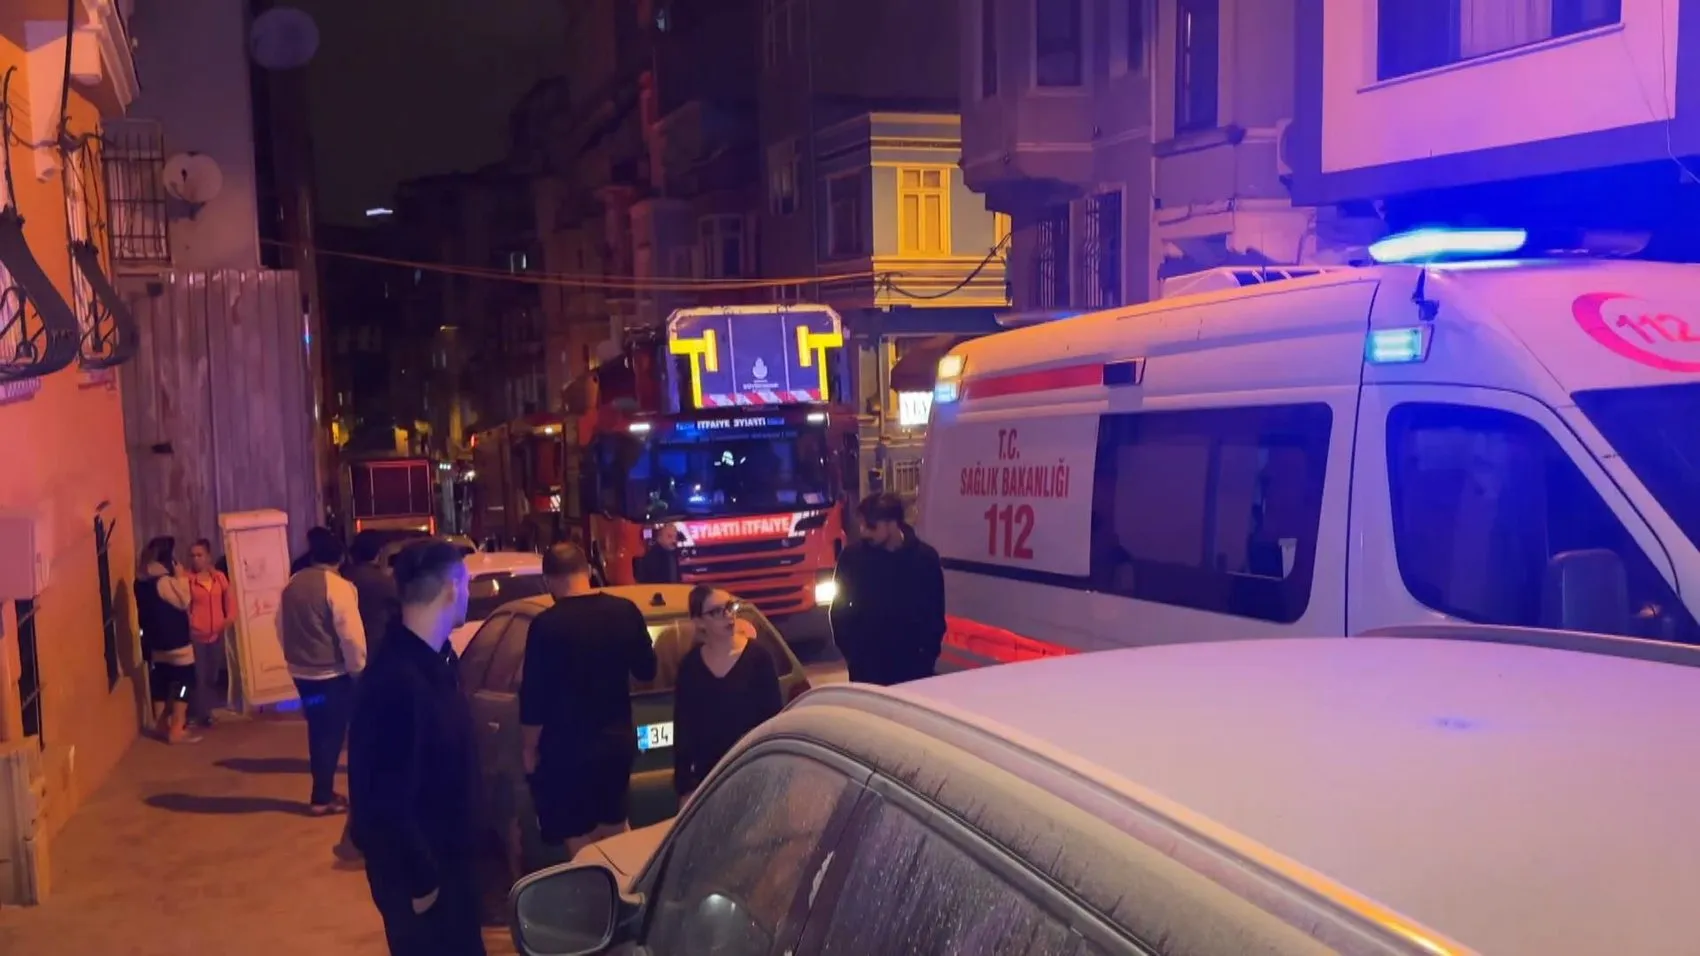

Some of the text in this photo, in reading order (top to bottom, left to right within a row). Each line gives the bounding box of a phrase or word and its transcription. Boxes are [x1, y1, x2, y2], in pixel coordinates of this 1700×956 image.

[1616, 312, 1700, 344] 112
[998, 428, 1020, 460] T.C.
[960, 458, 1070, 498] SAĞLIK BAKANLIĞI
[984, 503, 1035, 559] 112
[650, 726, 669, 744] 34
